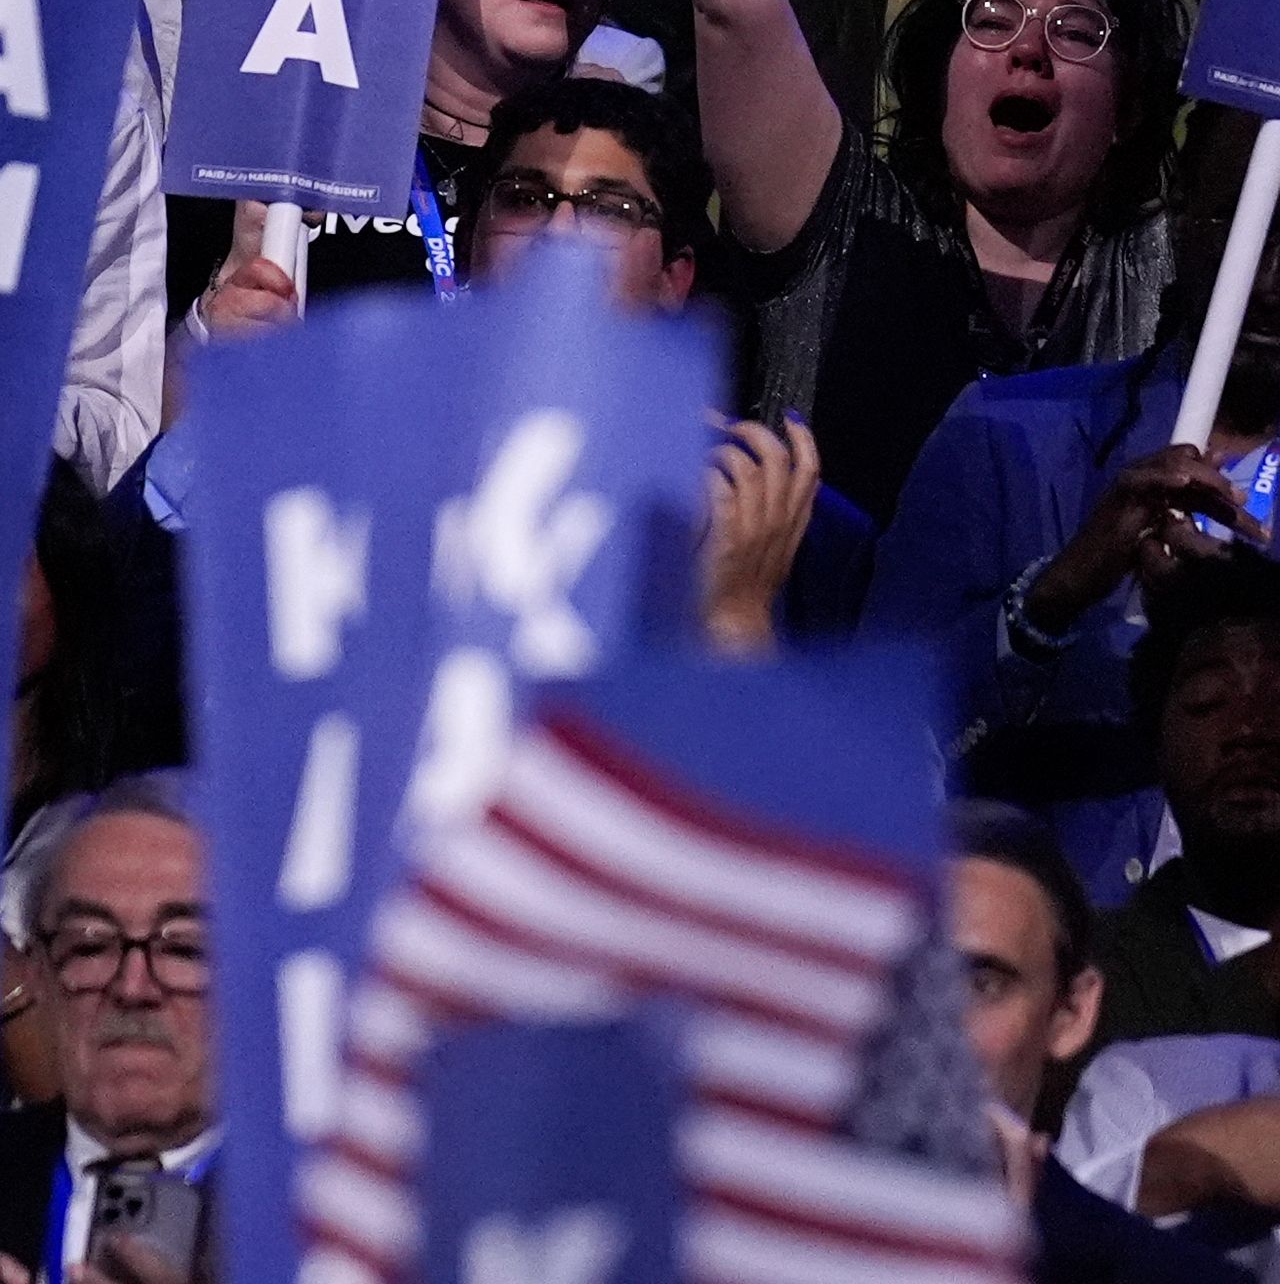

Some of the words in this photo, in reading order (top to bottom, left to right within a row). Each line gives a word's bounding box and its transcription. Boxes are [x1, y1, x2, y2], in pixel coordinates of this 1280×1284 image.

[198, 169, 225, 179] PAID
[248, 173, 290, 184] HARRIS
[291, 176, 313, 188] FOR
[313, 181, 376, 198] PRESIDENT
[426, 237, 454, 278] DNC
